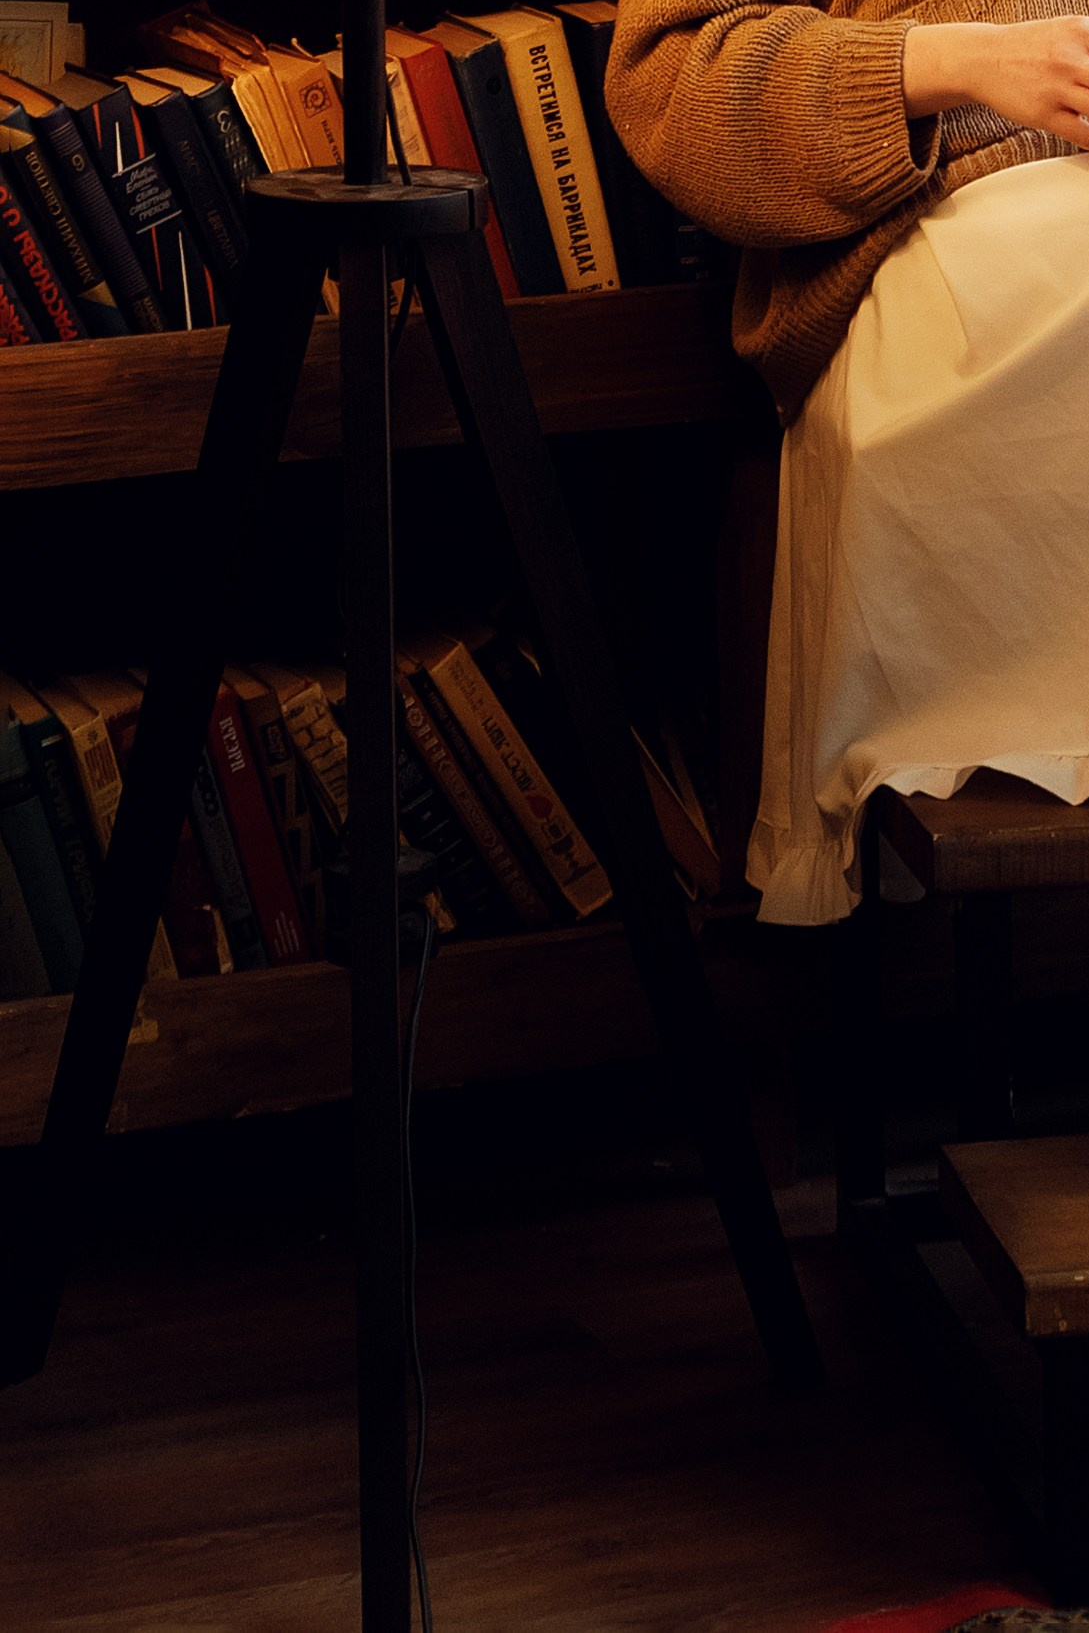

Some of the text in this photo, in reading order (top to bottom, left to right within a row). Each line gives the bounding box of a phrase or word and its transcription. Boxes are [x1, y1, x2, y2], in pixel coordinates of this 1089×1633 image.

[528, 43, 567, 143] ВСТРЕТИМСЯ
[550, 145, 572, 171] НА
[25, 151, 95, 284] МИХАИЛ СВЕТЛОВ
[556, 172, 598, 277] БАРРИКАДАХ
[13, 229, 78, 342] РАССКАЗЫ
